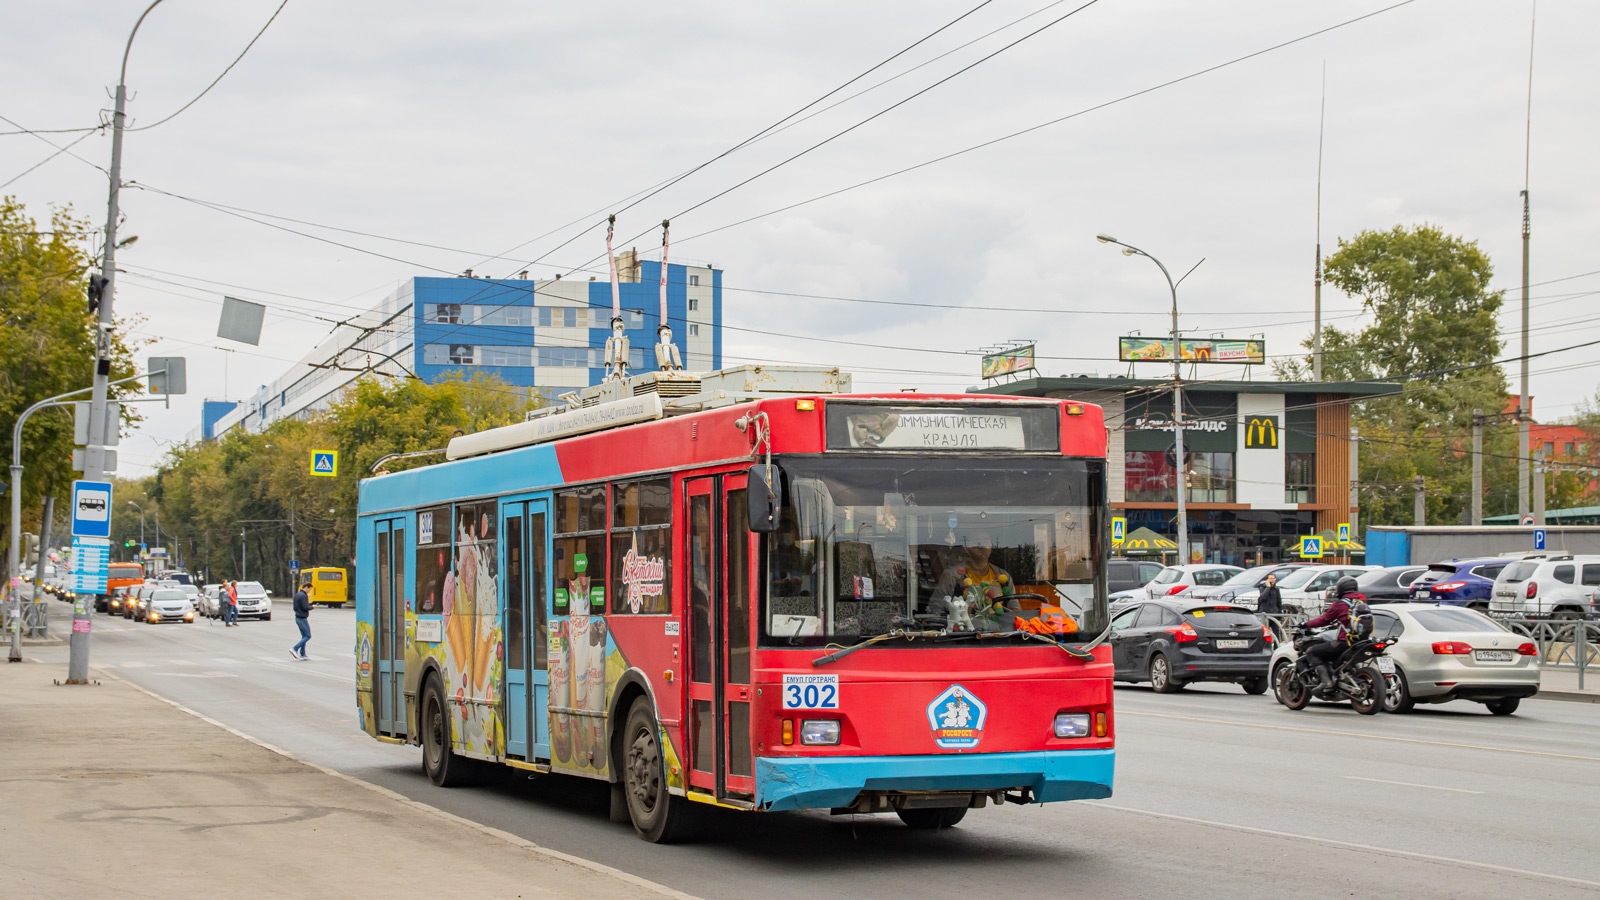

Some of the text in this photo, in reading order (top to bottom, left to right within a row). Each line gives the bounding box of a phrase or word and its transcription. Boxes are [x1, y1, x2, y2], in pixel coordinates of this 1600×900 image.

[897, 416, 1008, 430] ОММУНИСТИЧЕСКАЯ
[1135, 418, 1228, 433] Макдналдс
[923, 433, 978, 447] КРАУЛЯ
[422, 513, 432, 534] 302
[640, 585, 663, 595] СТАНДАРТ
[665, 623, 679, 632] ВЫХОД
[786, 684, 836, 708] 302
